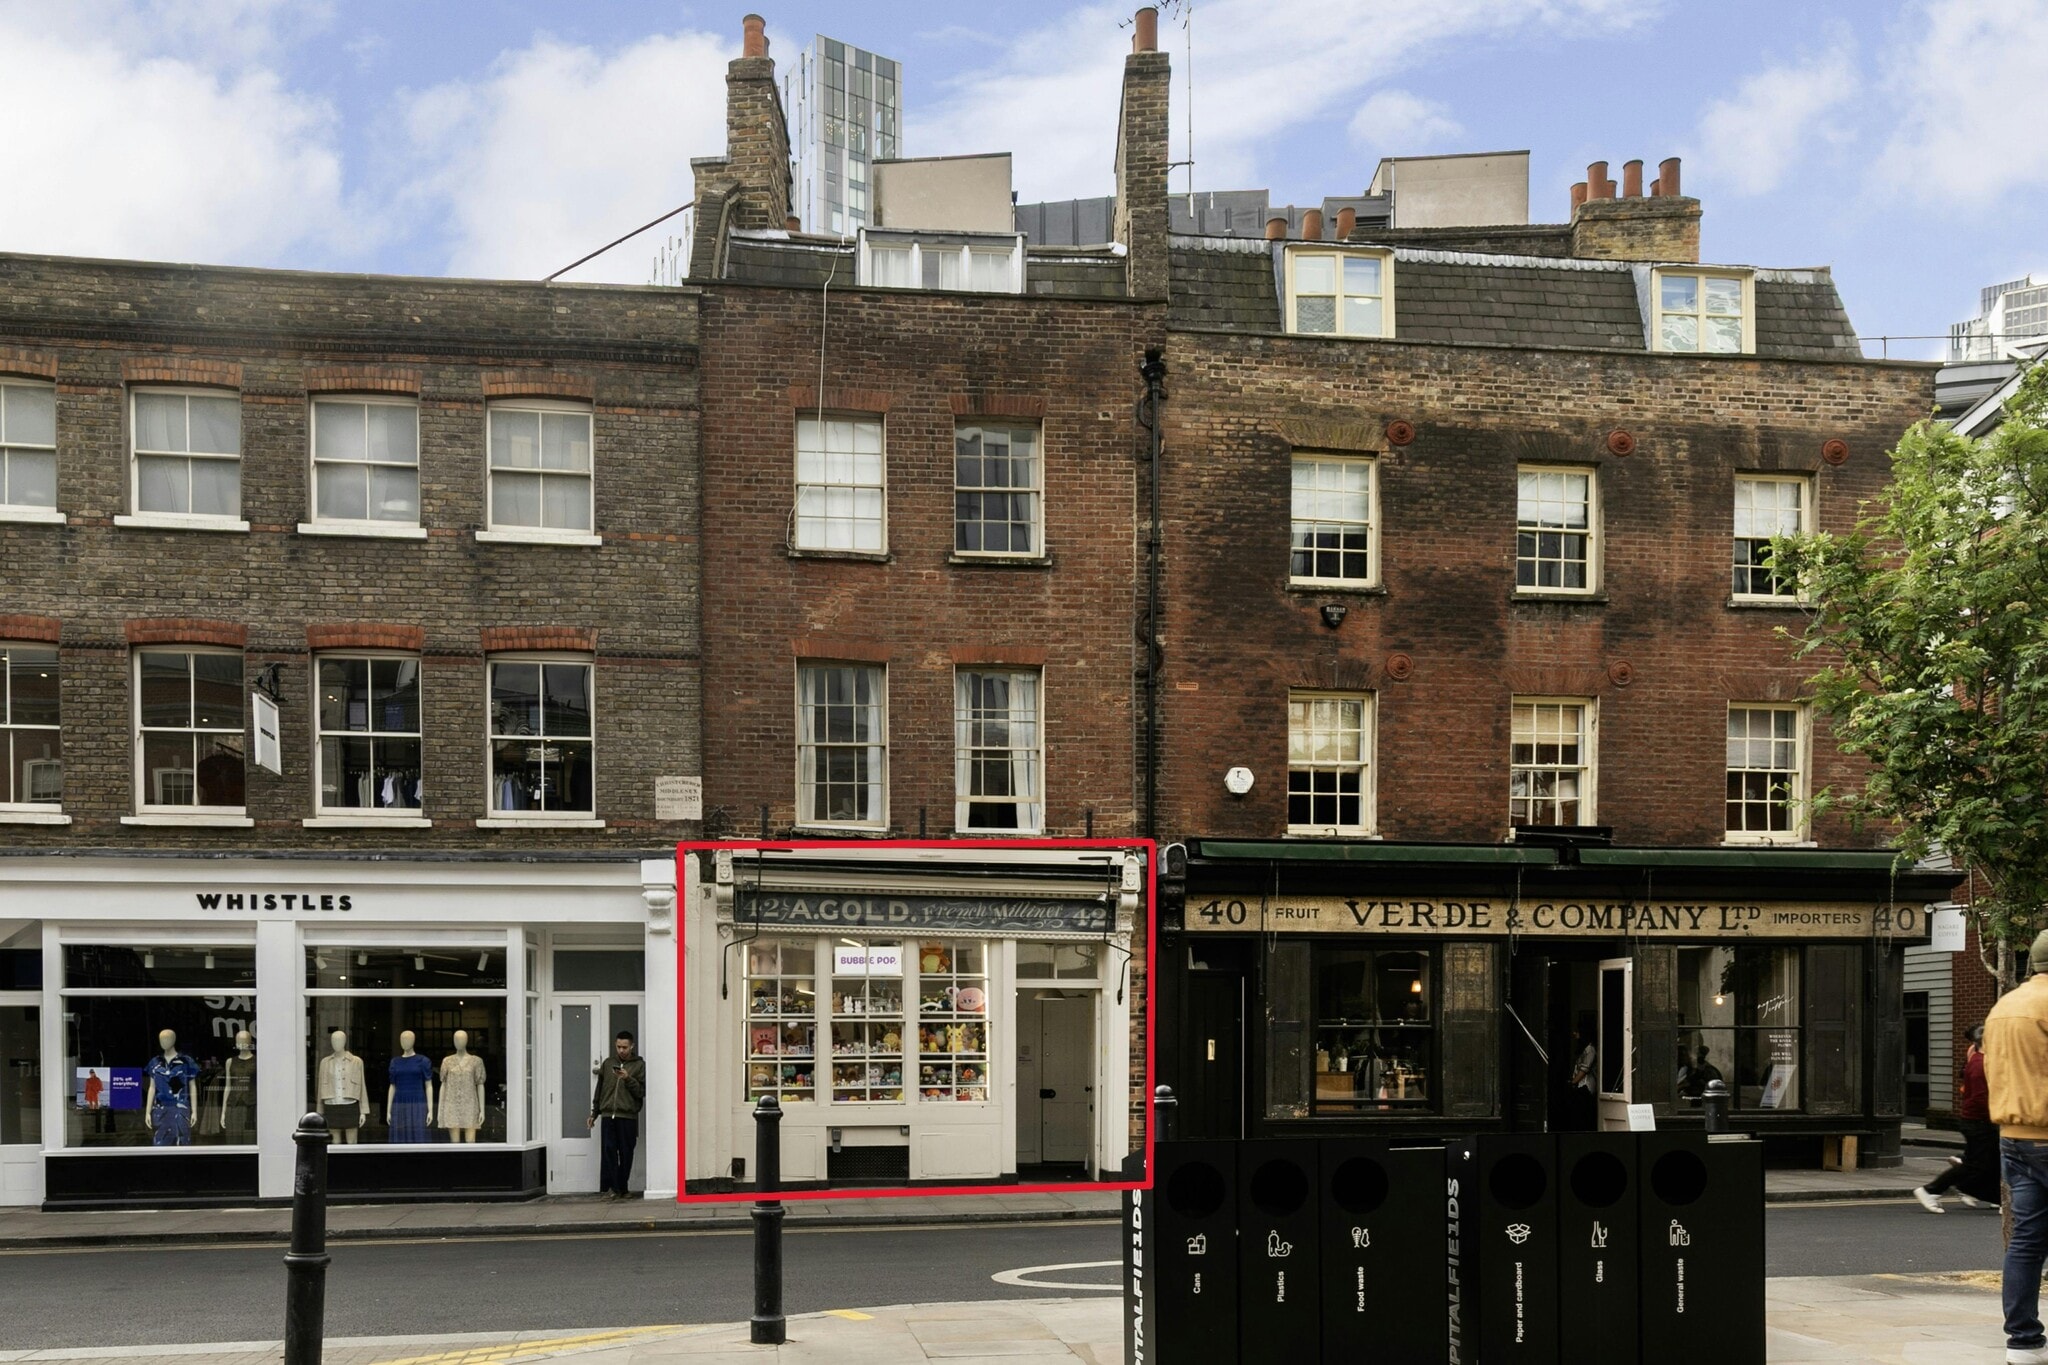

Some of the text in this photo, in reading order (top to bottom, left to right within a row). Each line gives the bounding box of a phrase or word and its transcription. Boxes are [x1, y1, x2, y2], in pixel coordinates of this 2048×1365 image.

[196, 894, 352, 911] WHISTLES
[922, 901, 987, 923] French
[989, 901, 1064, 924] Milliner
[1072, 907, 1108, 928] 42
[1199, 900, 1247, 925] 40
[1275, 907, 1320, 919] FRUIT
[1345, 901, 1492, 928] VERDE
[1505, 906, 1524, 928] &
[1532, 904, 1708, 930] COMPANY
[1773, 912, 1861, 925] IMPORTERS
[1874, 906, 1915, 931] 40
[840, 956, 875, 965] BUBBE
[955, 1087, 985, 1097] OPEN
[1193, 1272, 1201, 1294] Cans
[1595, 1260, 1604, 1282] Glass
[1277, 1271, 1285, 1302] Plastics
[1357, 1266, 1365, 1312] Food waste
[1676, 1282, 1684, 1313] General
[1515, 1262, 1525, 1343] Paper and cardboard
